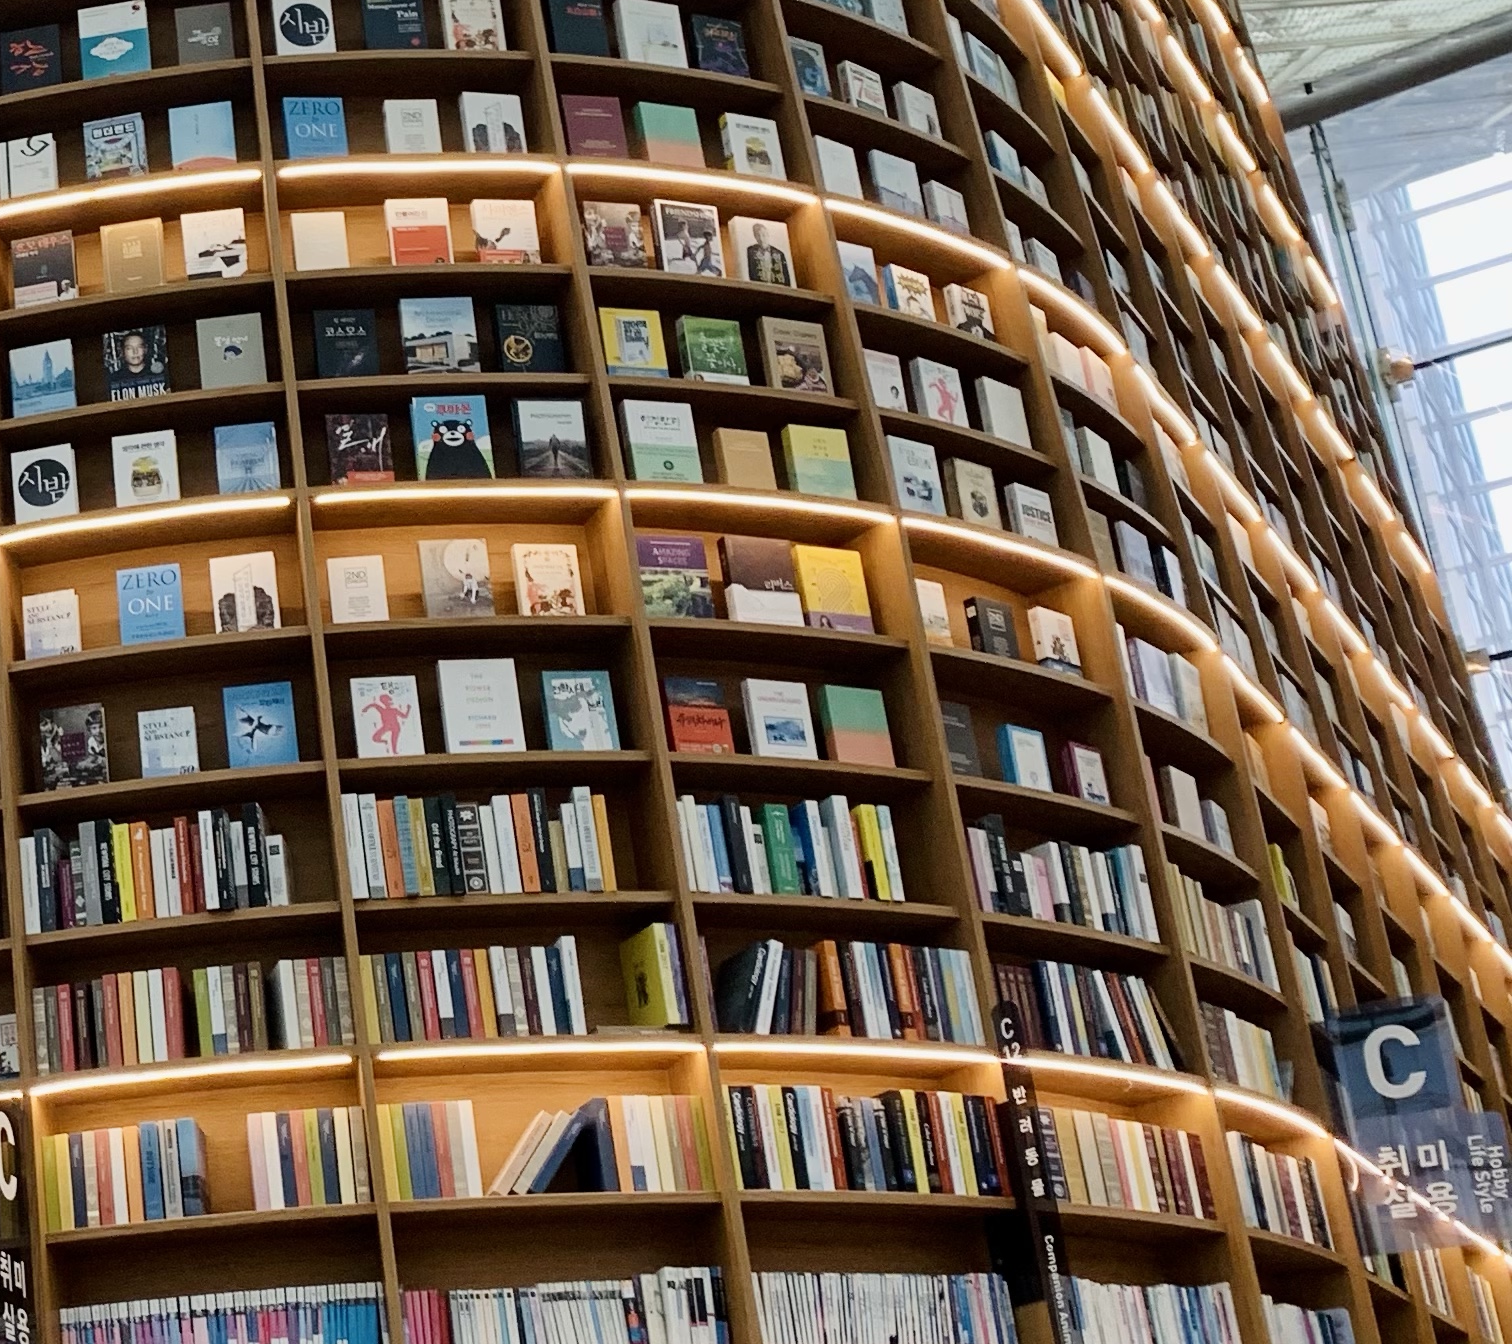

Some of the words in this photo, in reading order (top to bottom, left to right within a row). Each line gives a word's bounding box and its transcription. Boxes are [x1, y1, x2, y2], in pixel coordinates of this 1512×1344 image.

[280, 6, 330, 45] 시밤
[396, 9, 419, 18] Pain
[288, 100, 341, 117] ZERO
[294, 122, 338, 138] ONE
[110, 386, 136, 403] ELON
[138, 381, 167, 399] MUSK
[18, 464, 70, 503] 시밤
[121, 568, 177, 591] ZERO
[127, 594, 174, 616] ONE
[142, 721, 168, 730] STYLE
[143, 729, 191, 741] SUBSTANCE
[1000, 1016, 1015, 1040] C
[1363, 1023, 1428, 1100] C
[732, 1091, 745, 1135] Cardiology
[1378, 1138, 1450, 1178] 취미
[1467, 1134, 1485, 1168] Life
[1487, 1144, 1510, 1202] Hobby
[1472, 1168, 1494, 1216] Style
[1044, 1233, 1067, 1311] Companion
